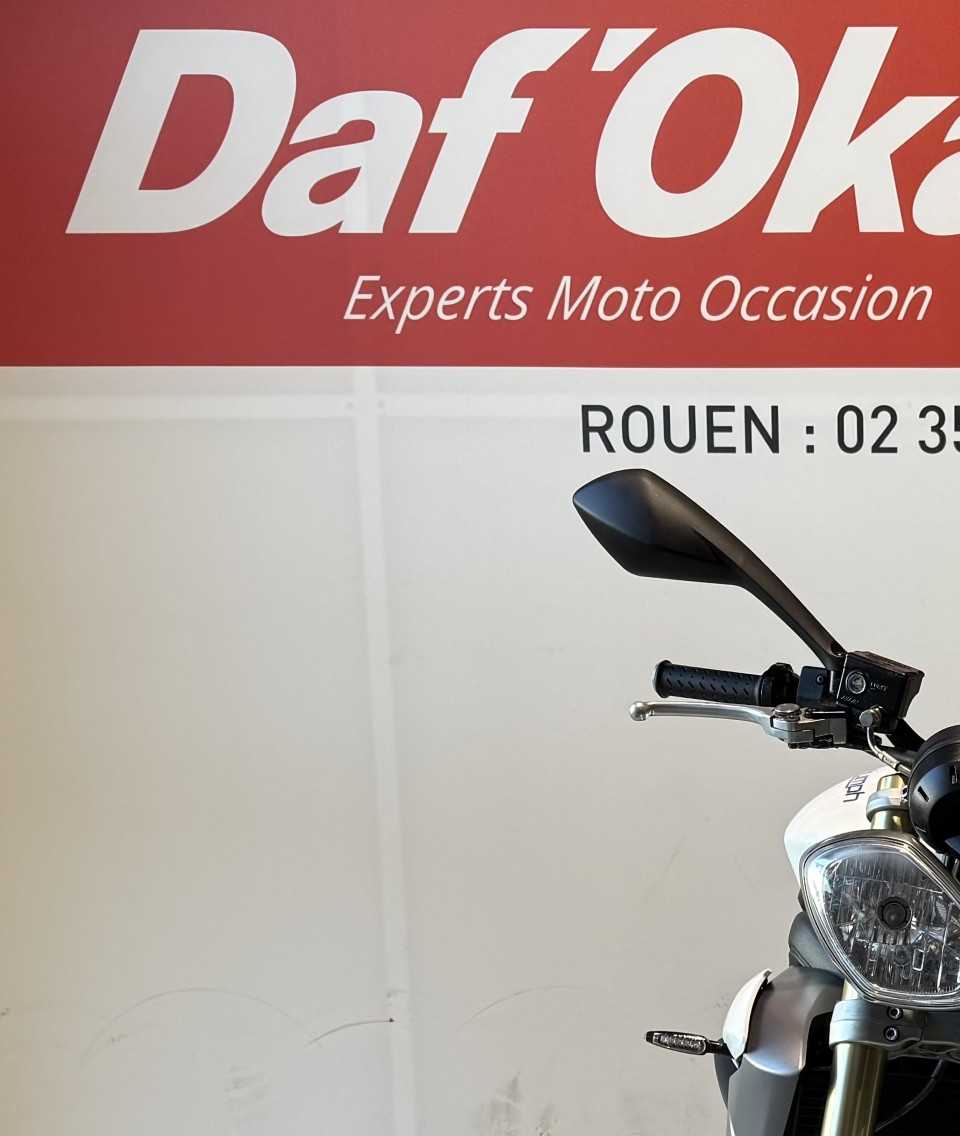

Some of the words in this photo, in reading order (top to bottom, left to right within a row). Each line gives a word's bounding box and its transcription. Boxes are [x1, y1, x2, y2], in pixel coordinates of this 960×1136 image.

[343, 275, 534, 335] Experts
[546, 275, 681, 322] Moto
[700, 273, 933, 322] Occasion
[581, 404, 780, 454] ROUEN
[837, 404, 898, 454] 02
